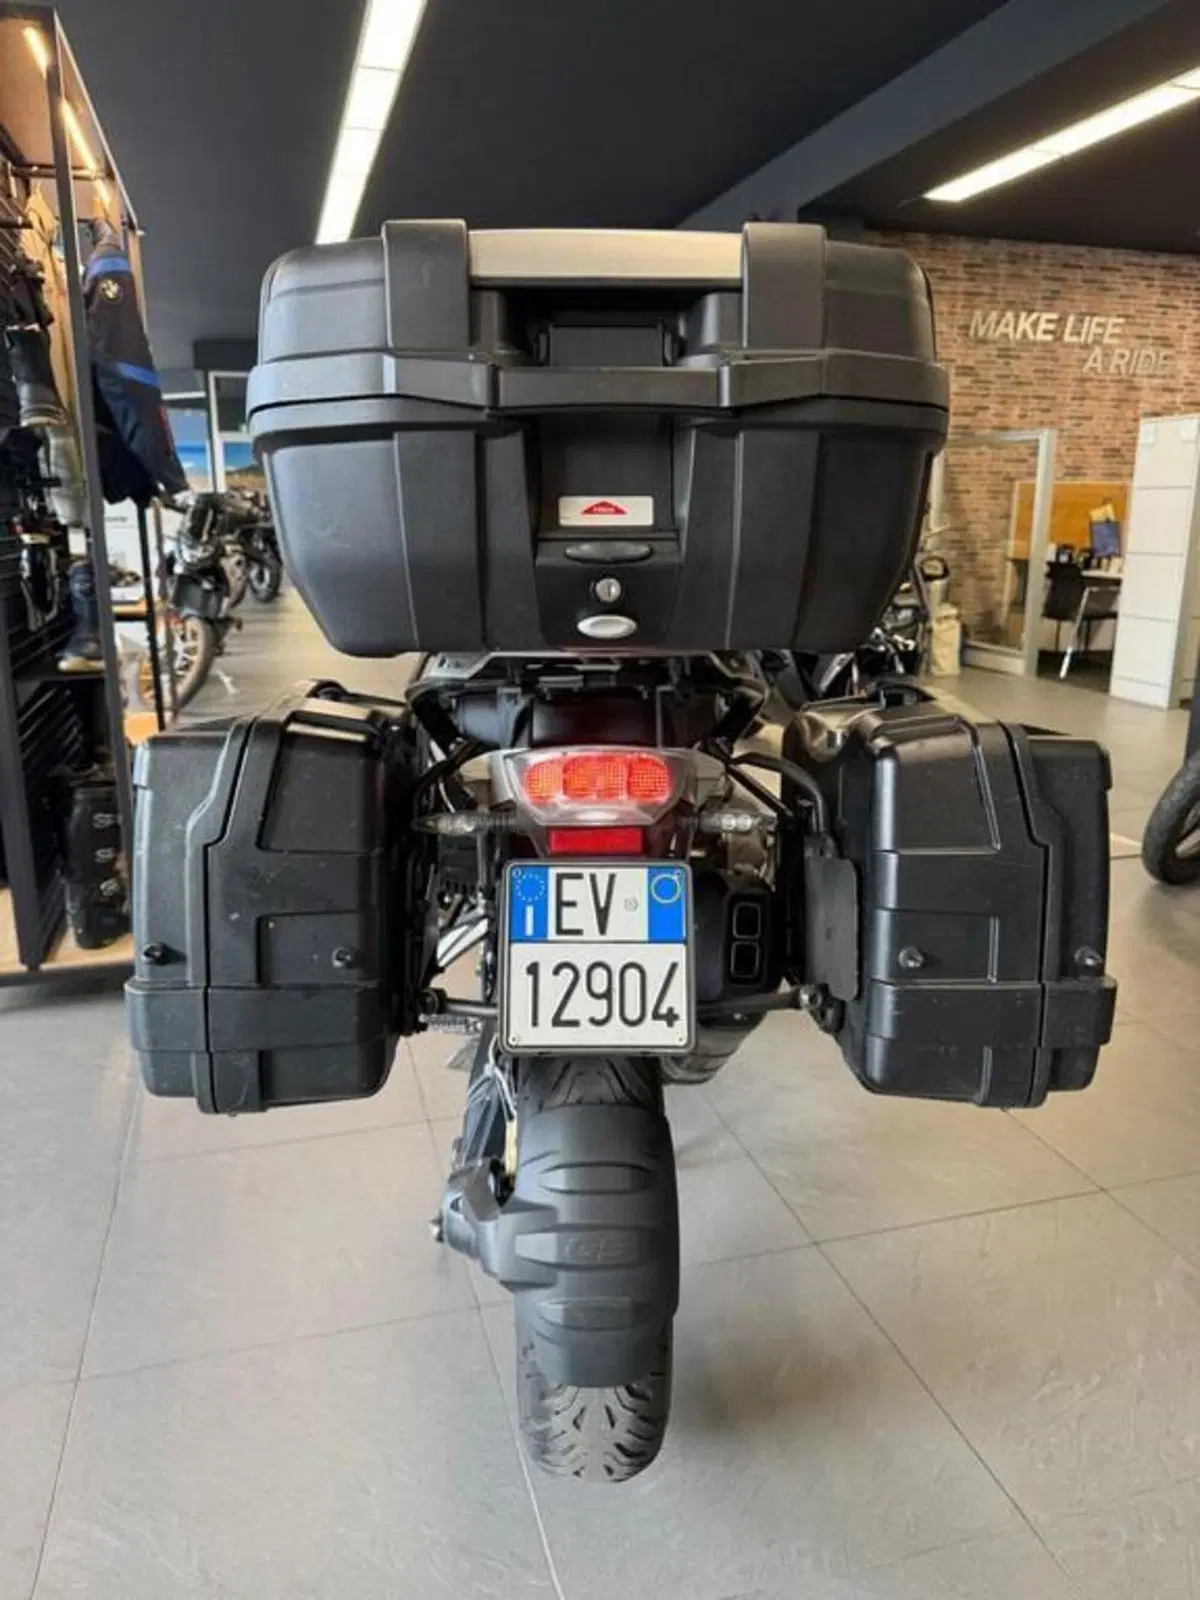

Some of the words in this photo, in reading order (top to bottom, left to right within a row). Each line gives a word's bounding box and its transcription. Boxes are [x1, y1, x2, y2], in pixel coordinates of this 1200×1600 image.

[969, 310, 1060, 342] MAKE
[1063, 314, 1125, 345] LIFE
[1082, 346, 1102, 374] A
[1109, 347, 1175, 375] RIDE
[555, 872, 617, 936] EV
[526, 961, 680, 1028] 12904
